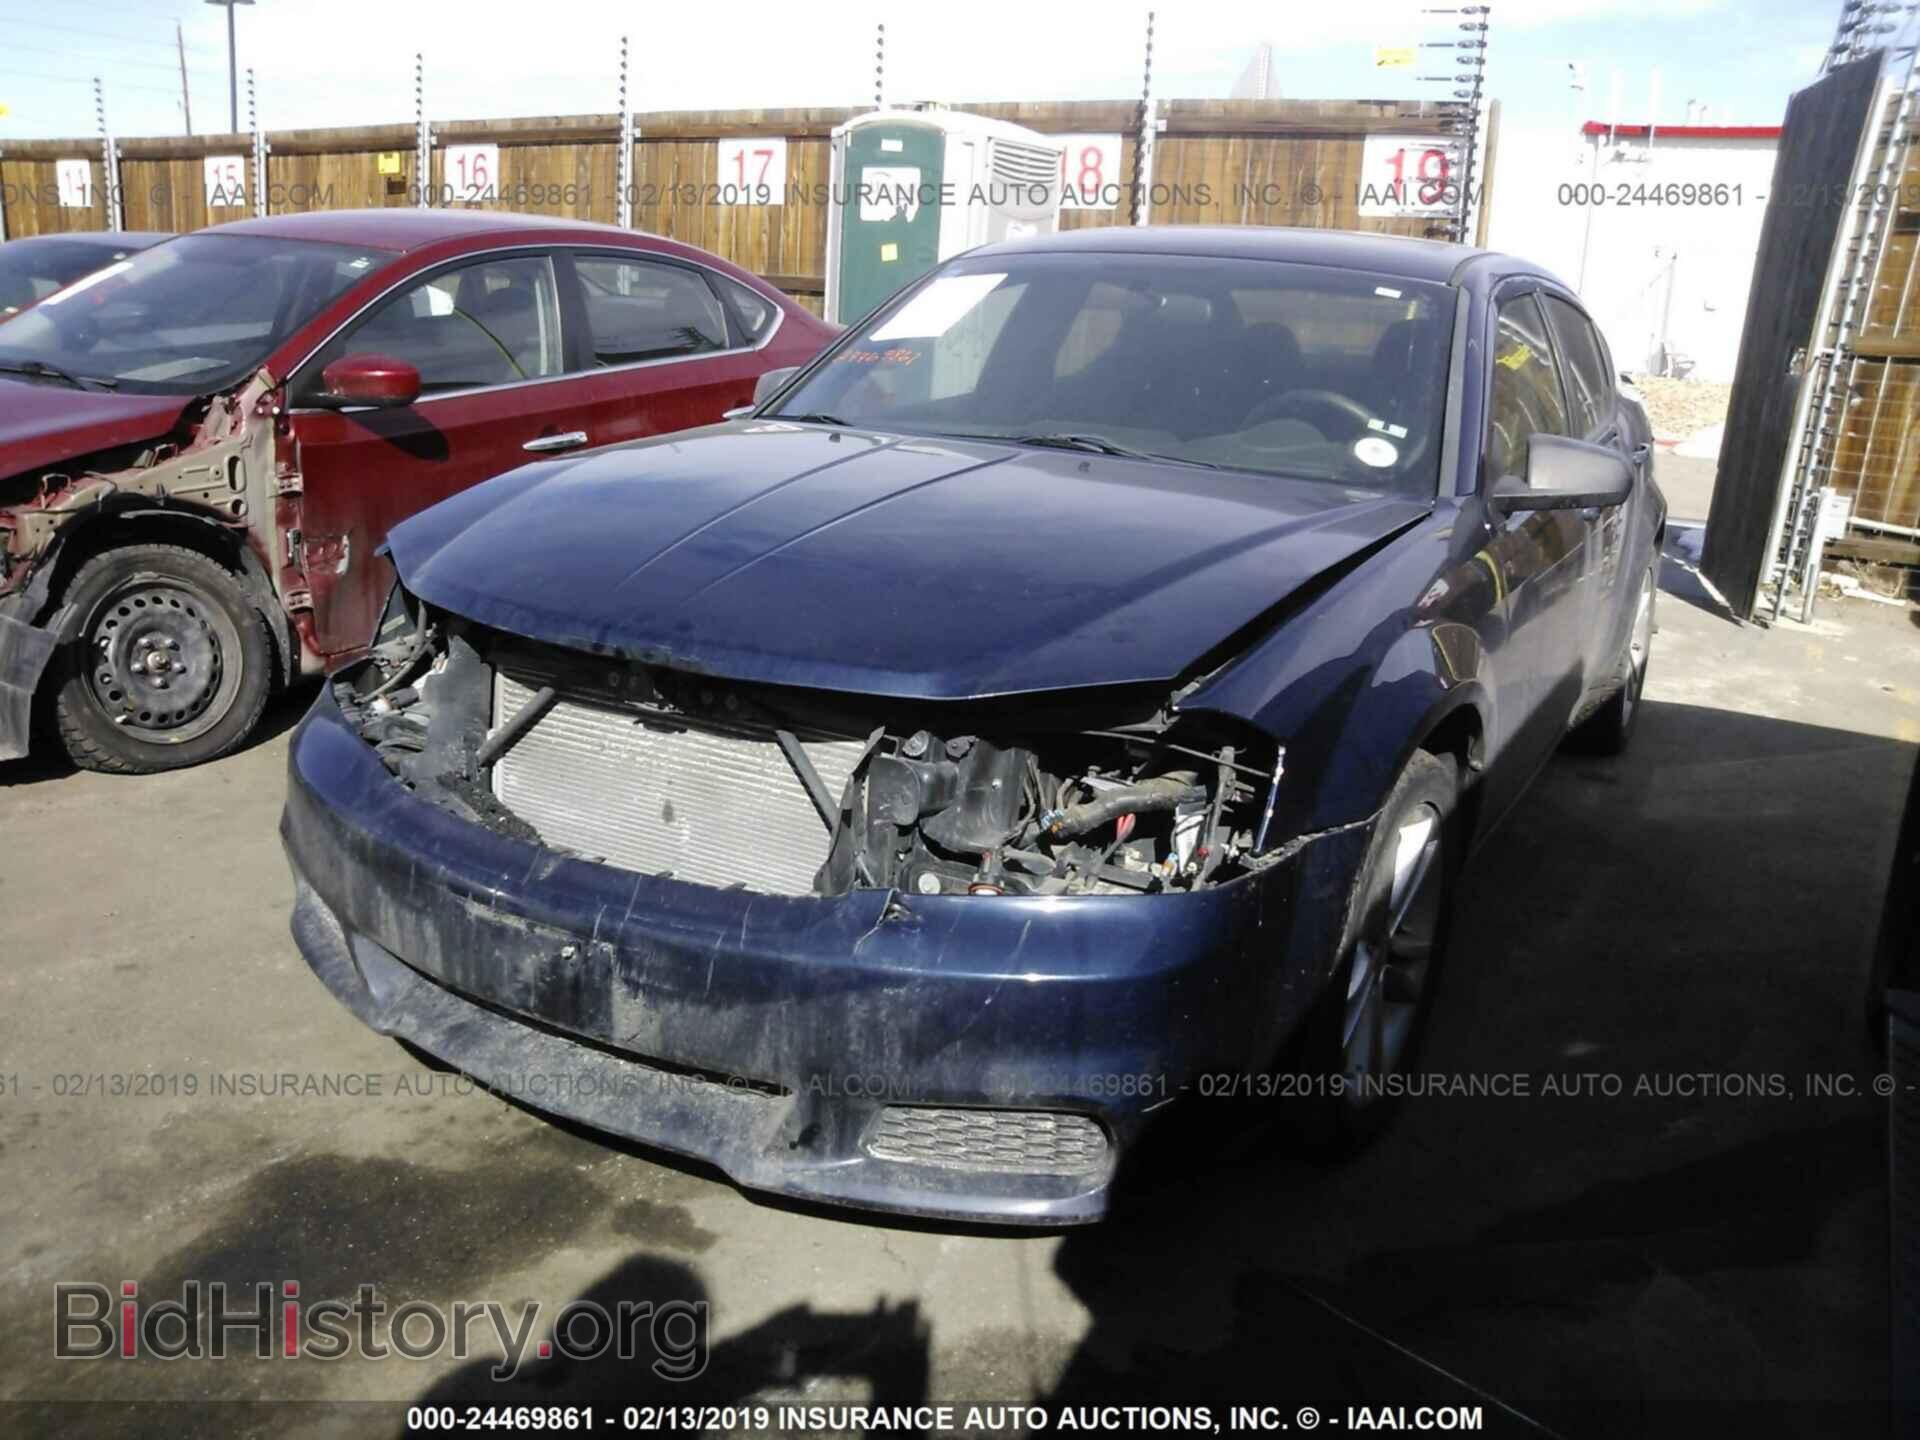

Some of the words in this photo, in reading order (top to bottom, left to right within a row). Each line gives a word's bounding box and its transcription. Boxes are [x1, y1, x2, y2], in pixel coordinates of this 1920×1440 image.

[212, 163, 238, 197] 15
[457, 152, 488, 190] 16
[733, 149, 773, 190] 17
[1061, 146, 1102, 193] 18
[1384, 147, 1450, 206] 19
